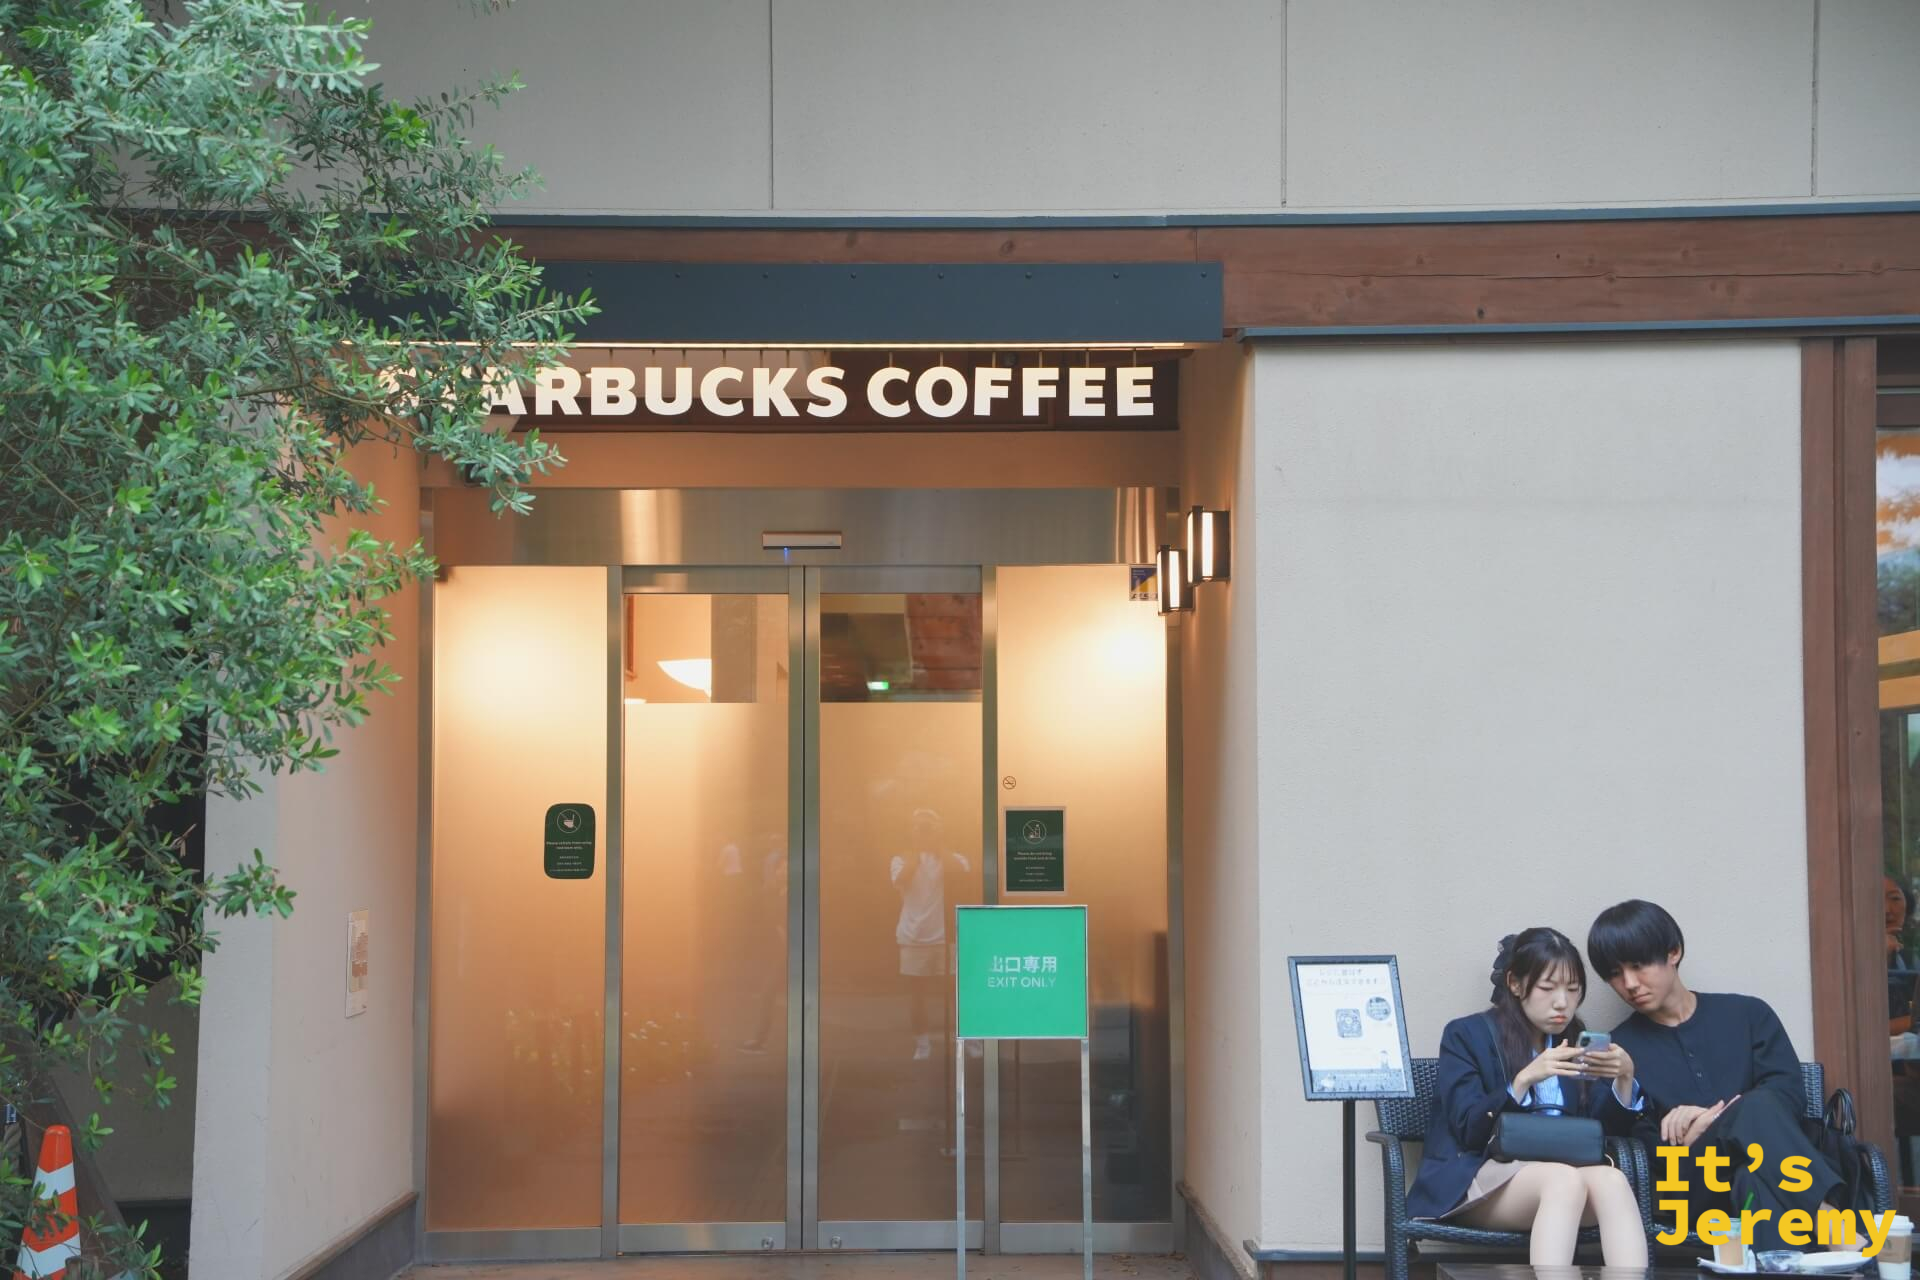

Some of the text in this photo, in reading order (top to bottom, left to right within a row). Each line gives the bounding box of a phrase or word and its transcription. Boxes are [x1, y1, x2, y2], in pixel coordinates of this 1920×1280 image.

[867, 366, 1154, 418] COFFEE
[988, 955, 1057, 973] 出口専用
[987, 976, 1057, 988] EXIT ONLY
